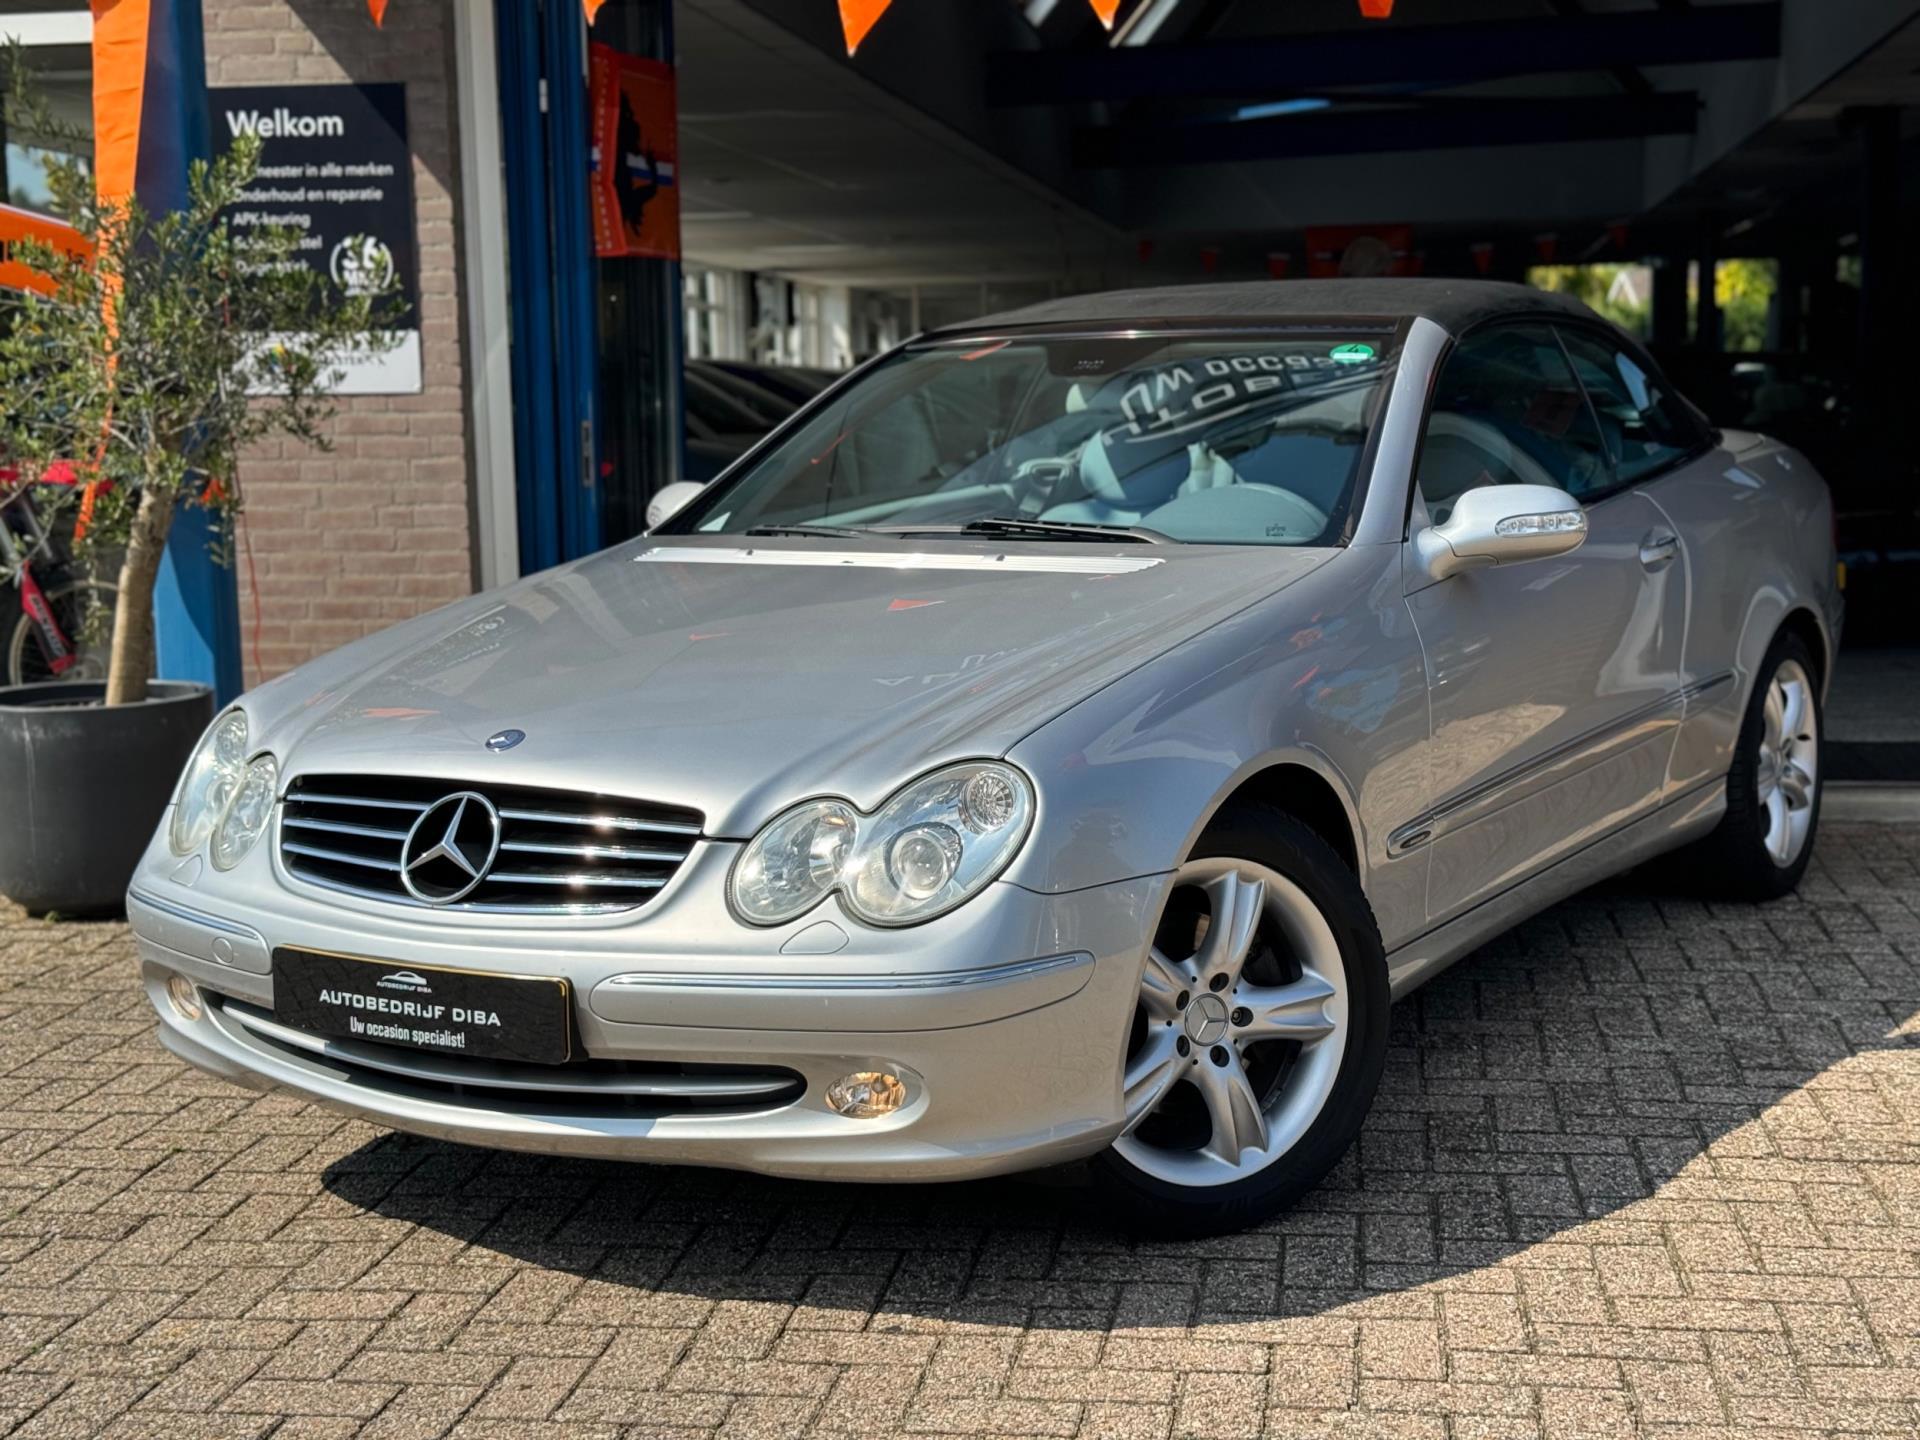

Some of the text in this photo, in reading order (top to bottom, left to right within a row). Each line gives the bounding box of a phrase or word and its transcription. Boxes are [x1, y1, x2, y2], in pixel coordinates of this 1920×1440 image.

[225, 107, 345, 138] Welkom
[304, 163, 320, 178] in
[319, 161, 344, 178] alle
[344, 160, 395, 177] merken
[232, 186, 385, 204] Onderhoud en reparatie
[232, 210, 312, 229] APK-keuring
[416, 985, 433, 994] DIBA
[319, 988, 502, 1027] AUTOBEDRIJF DIBA
[349, 1015, 466, 1049] Uw occasion specialist!
